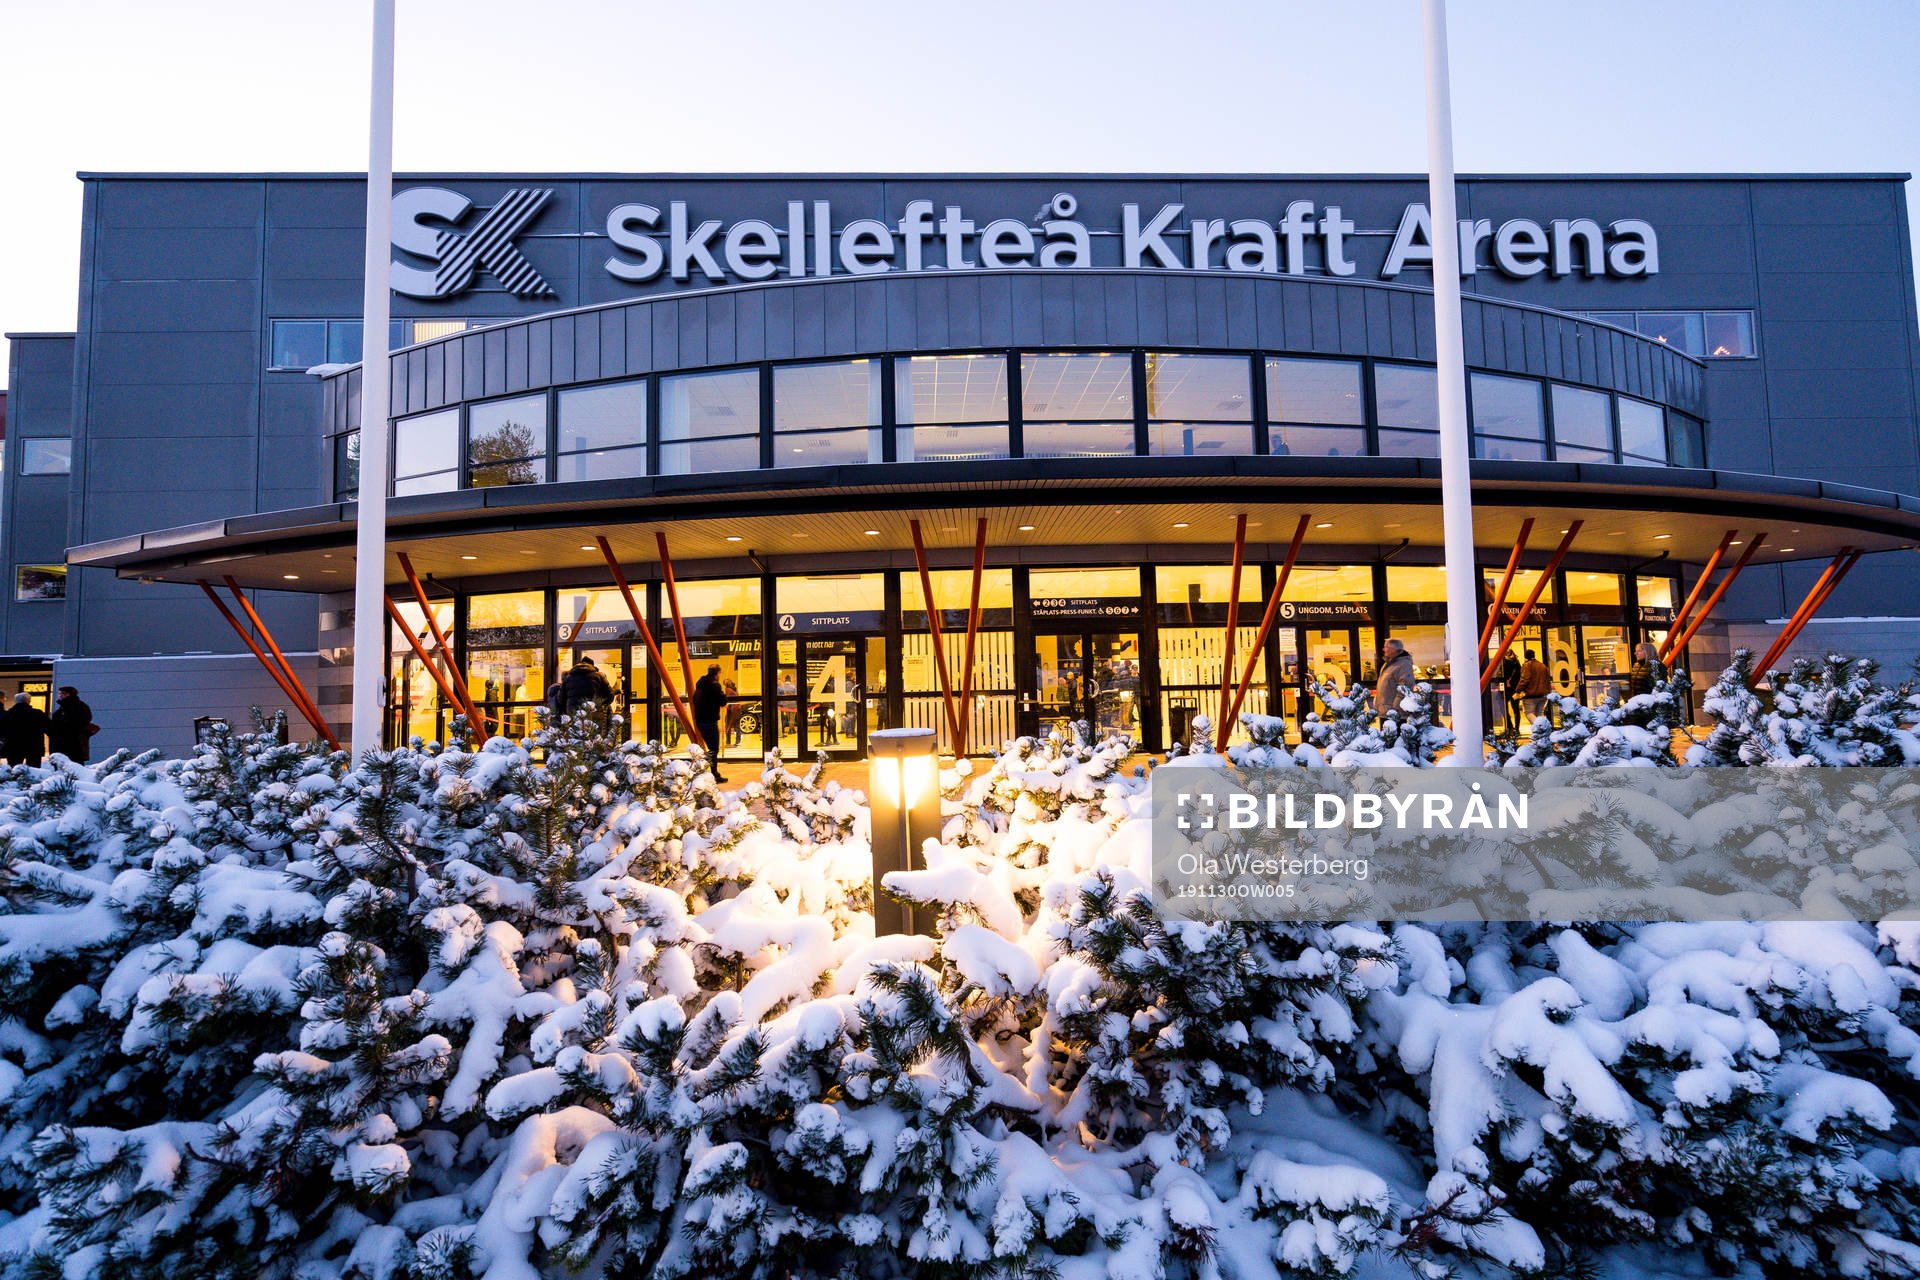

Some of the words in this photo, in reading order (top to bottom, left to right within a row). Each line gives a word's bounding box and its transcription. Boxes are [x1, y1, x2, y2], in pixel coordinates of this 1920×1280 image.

[604, 192, 1092, 283] Skellefteå
[1121, 199, 1356, 277] Kraft
[1381, 201, 1660, 279] Arena
[1284, 604, 1292, 617] 5
[1298, 606, 1334, 614] UNGDOM,
[1335, 605, 1368, 614] STÅPLATS
[782, 616, 793, 629] 4
[811, 616, 850, 626] SITTPLATS
[562, 626, 570, 638] 3
[585, 626, 618, 634] SITTPLATS
[729, 640, 752, 652] Vinn
[810, 655, 855, 714] 4
